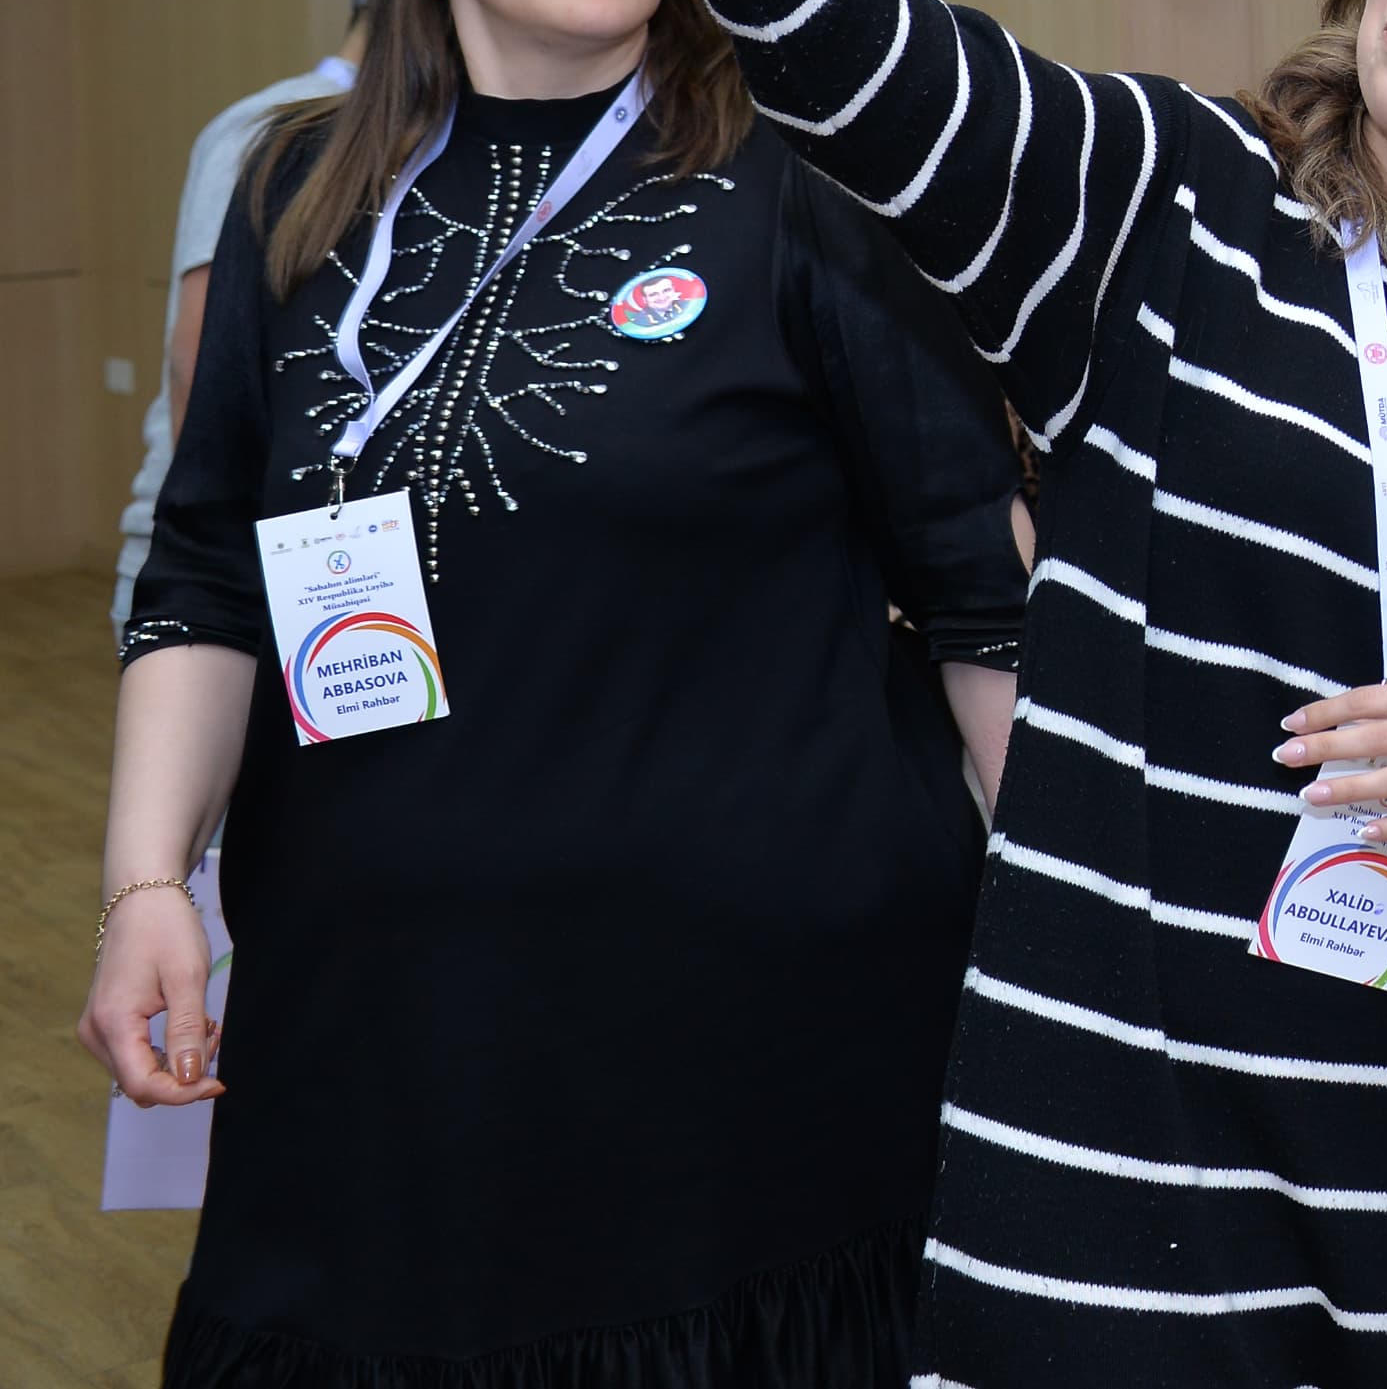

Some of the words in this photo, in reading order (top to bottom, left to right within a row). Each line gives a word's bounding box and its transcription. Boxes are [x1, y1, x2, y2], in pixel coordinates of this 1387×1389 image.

[298, 597, 314, 606] XIV
[317, 587, 363, 602] Respublika
[323, 596, 370, 611] Müsabiqəsi
[316, 649, 403, 679] MEHRİBAN
[322, 670, 408, 700] ABBASOVA
[336, 703, 360, 715] Elmi
[362, 694, 400, 711] Rəhbər
[1332, 811, 1349, 821] XIV
[1300, 932, 1324, 948] Elmi
[1326, 939, 1365, 959] Rəhbər
